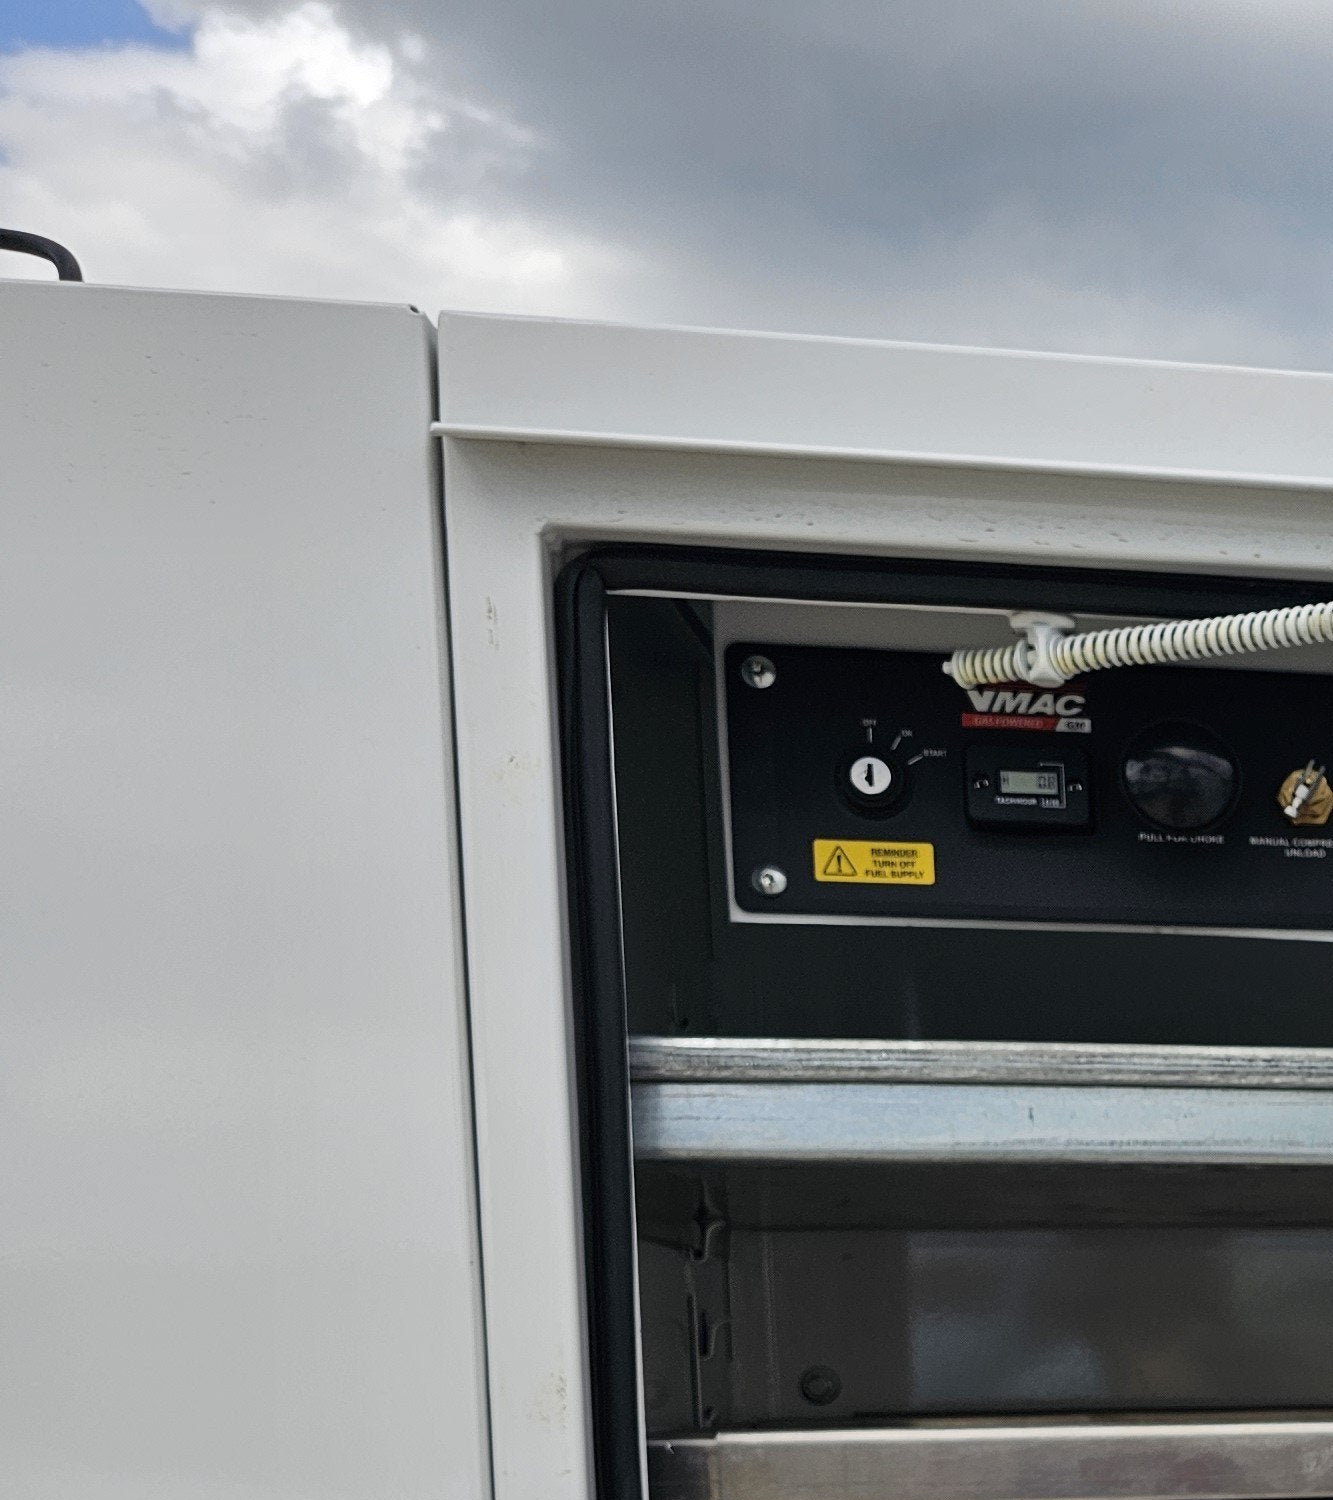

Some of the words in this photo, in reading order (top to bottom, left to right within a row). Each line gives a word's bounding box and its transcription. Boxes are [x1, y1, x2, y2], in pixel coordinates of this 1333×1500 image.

[967, 690, 1086, 716] VMAC
[1138, 832, 1165, 843] PULL
[1249, 836, 1290, 847] MANUAL
[871, 848, 918, 858] REMINDER
[1284, 849, 1326, 859] UNLOAD
[873, 860, 897, 868] TURN
[899, 861, 916, 869] OFF
[865, 869, 887, 878] FUEL
[891, 871, 925, 880] SUPPLY
